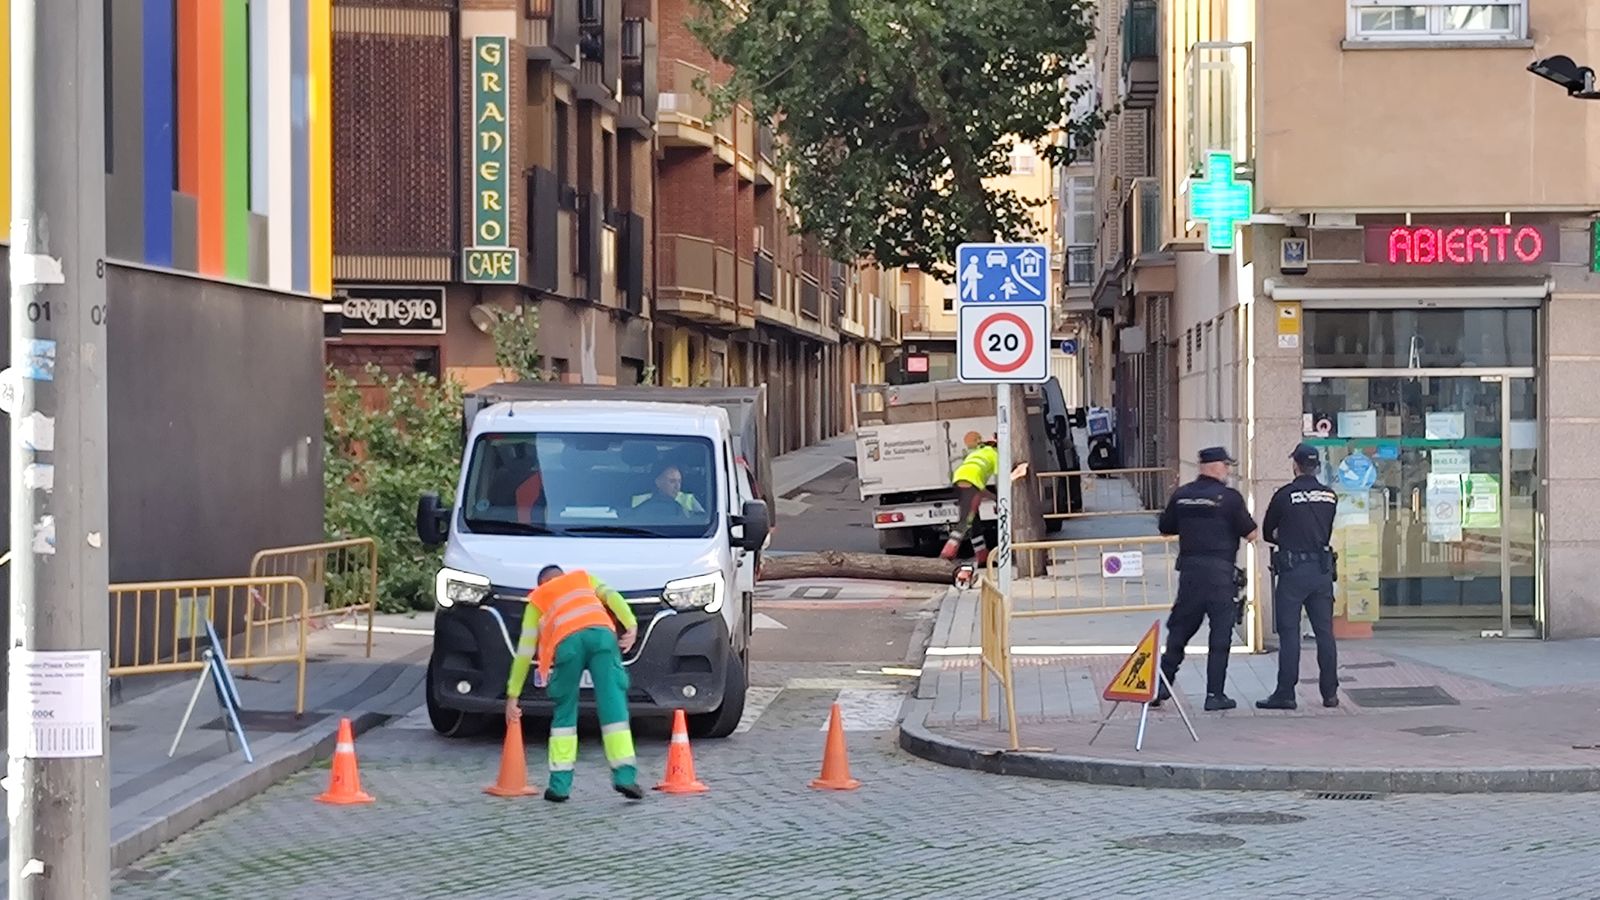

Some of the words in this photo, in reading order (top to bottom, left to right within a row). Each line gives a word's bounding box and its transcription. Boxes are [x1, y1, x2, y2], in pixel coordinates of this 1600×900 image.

[479, 43, 504, 241] GRANERO
[1388, 226, 1543, 264] ABIERTO
[469, 252, 512, 279] CAFE
[27, 301, 51, 322] 01
[342, 298, 437, 326] GRANERO
[988, 333, 1019, 352] 20
